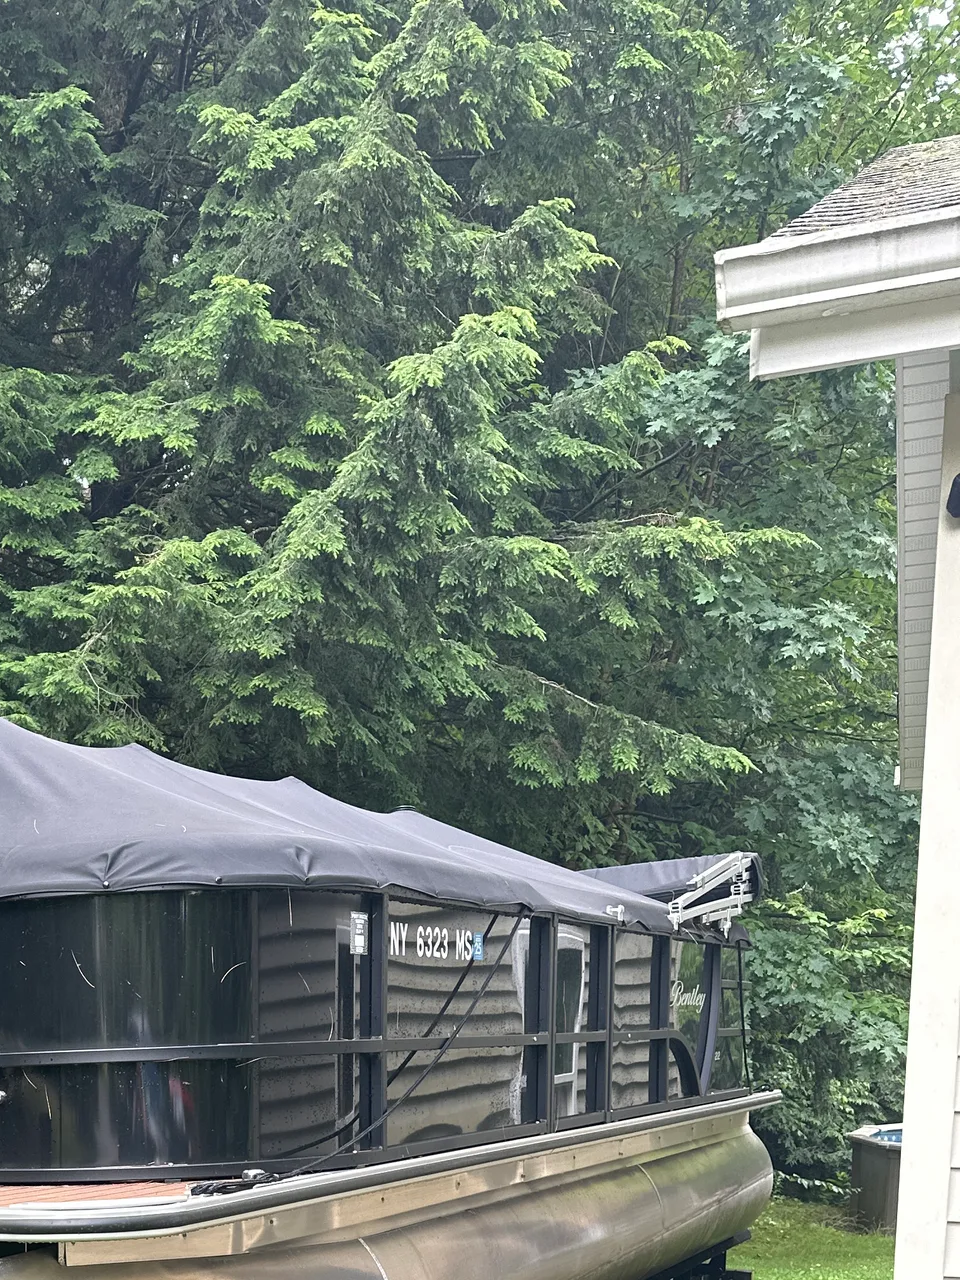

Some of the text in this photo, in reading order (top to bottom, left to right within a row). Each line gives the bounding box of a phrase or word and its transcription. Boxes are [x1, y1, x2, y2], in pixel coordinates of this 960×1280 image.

[390, 921, 409, 956] NY
[416, 925, 449, 959] 6323
[455, 929, 472, 961] MS
[669, 980, 706, 1014] Bentley
